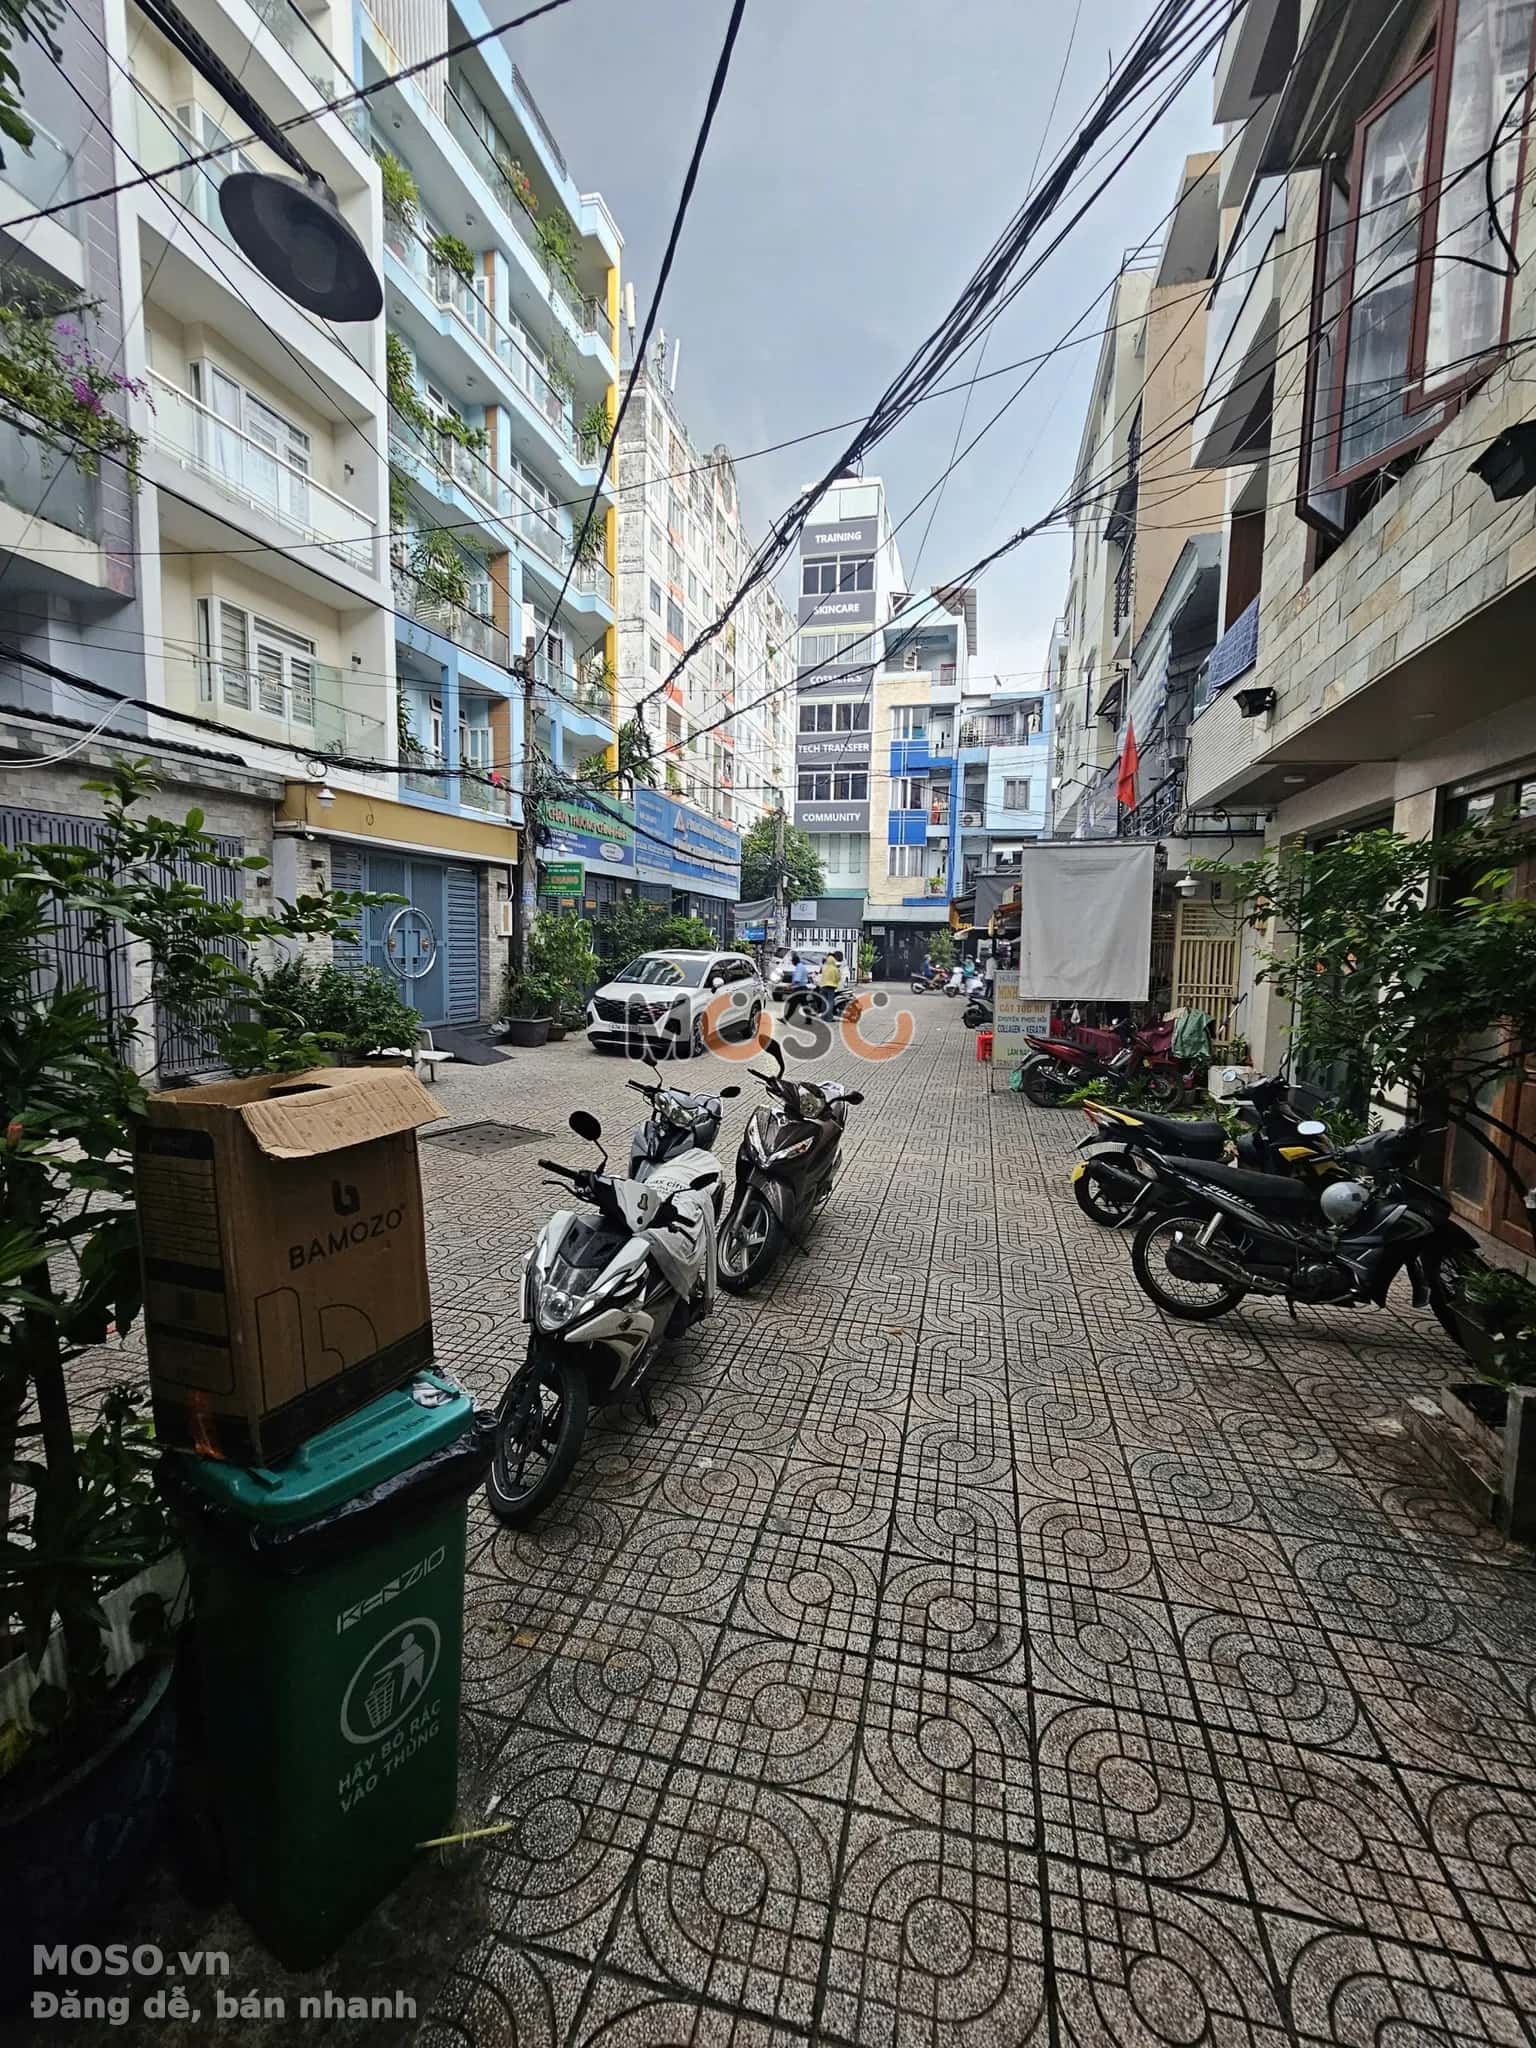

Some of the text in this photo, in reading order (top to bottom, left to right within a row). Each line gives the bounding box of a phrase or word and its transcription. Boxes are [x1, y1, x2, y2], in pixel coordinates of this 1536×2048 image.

[816, 531, 862, 544] TRAINING
[814, 603, 860, 615] SKINCARE
[797, 743, 870, 753] TECH TRANSFER
[802, 812, 861, 822] COMMUNITY
[288, 1208, 402, 1272] BAMOZO
[338, 1698, 441, 1795] HÃY BỎ RÁC
[340, 1719, 440, 1813] VÀO THÙNG
